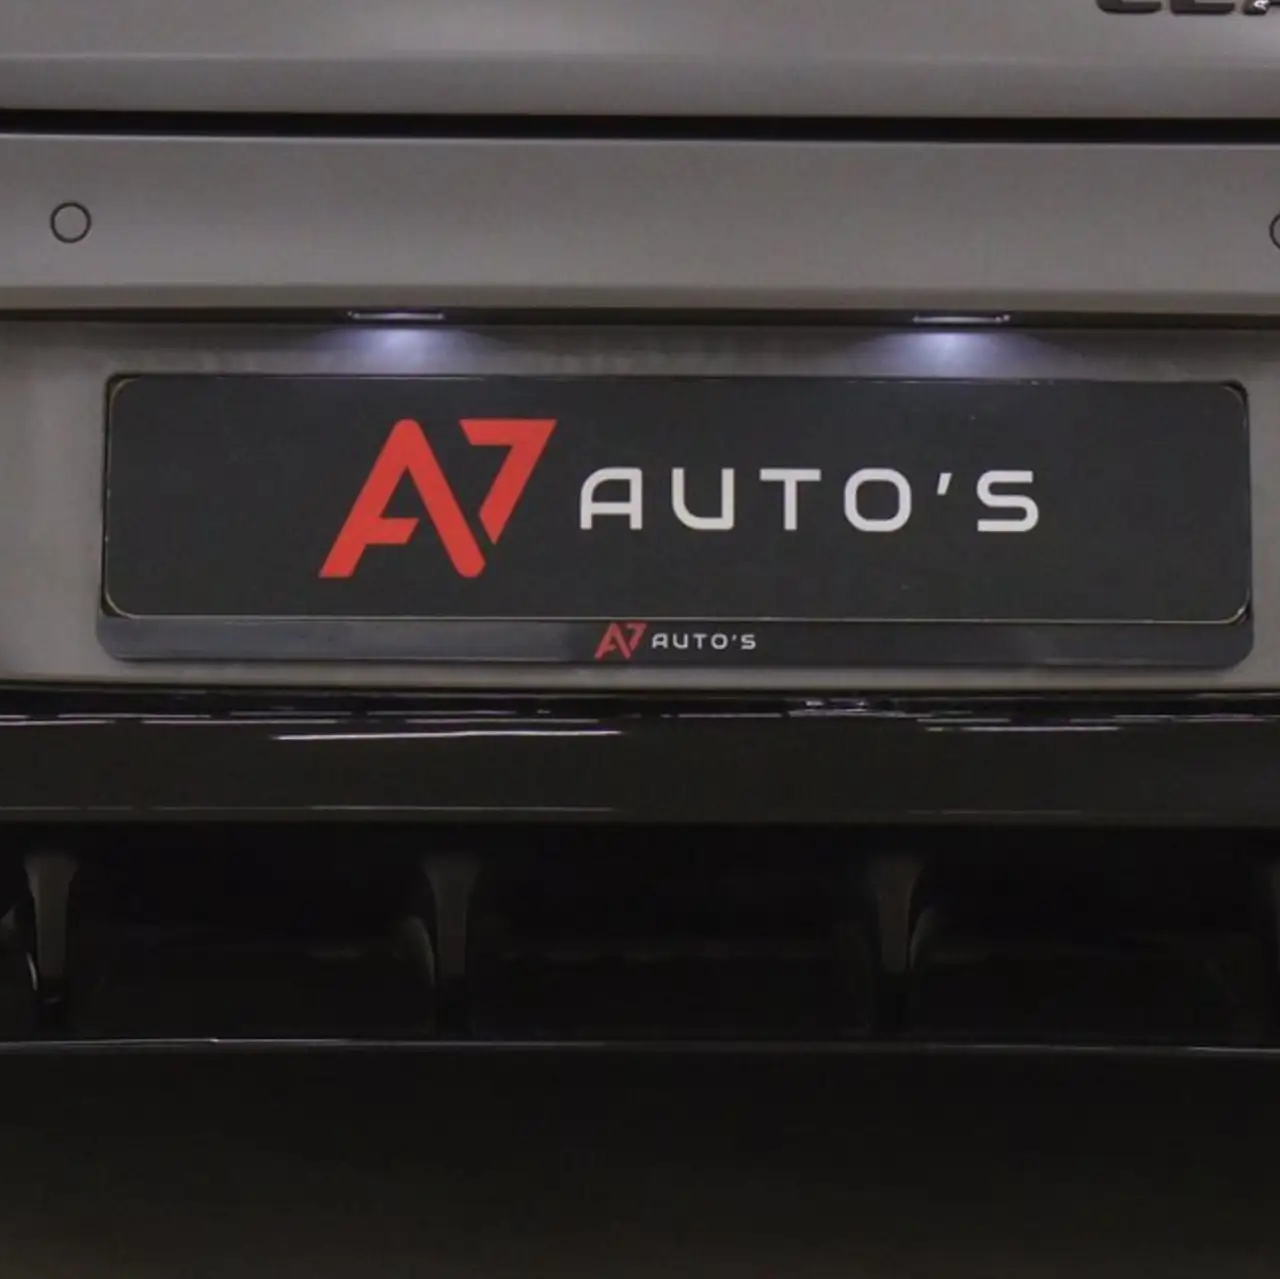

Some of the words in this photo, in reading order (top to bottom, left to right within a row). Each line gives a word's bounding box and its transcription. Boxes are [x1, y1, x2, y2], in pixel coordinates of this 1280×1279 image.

[319, 418, 558, 579] A7
[579, 467, 1040, 533] AUTO'S
[594, 622, 648, 660] A7
[651, 632, 757, 651] AUTO'S
